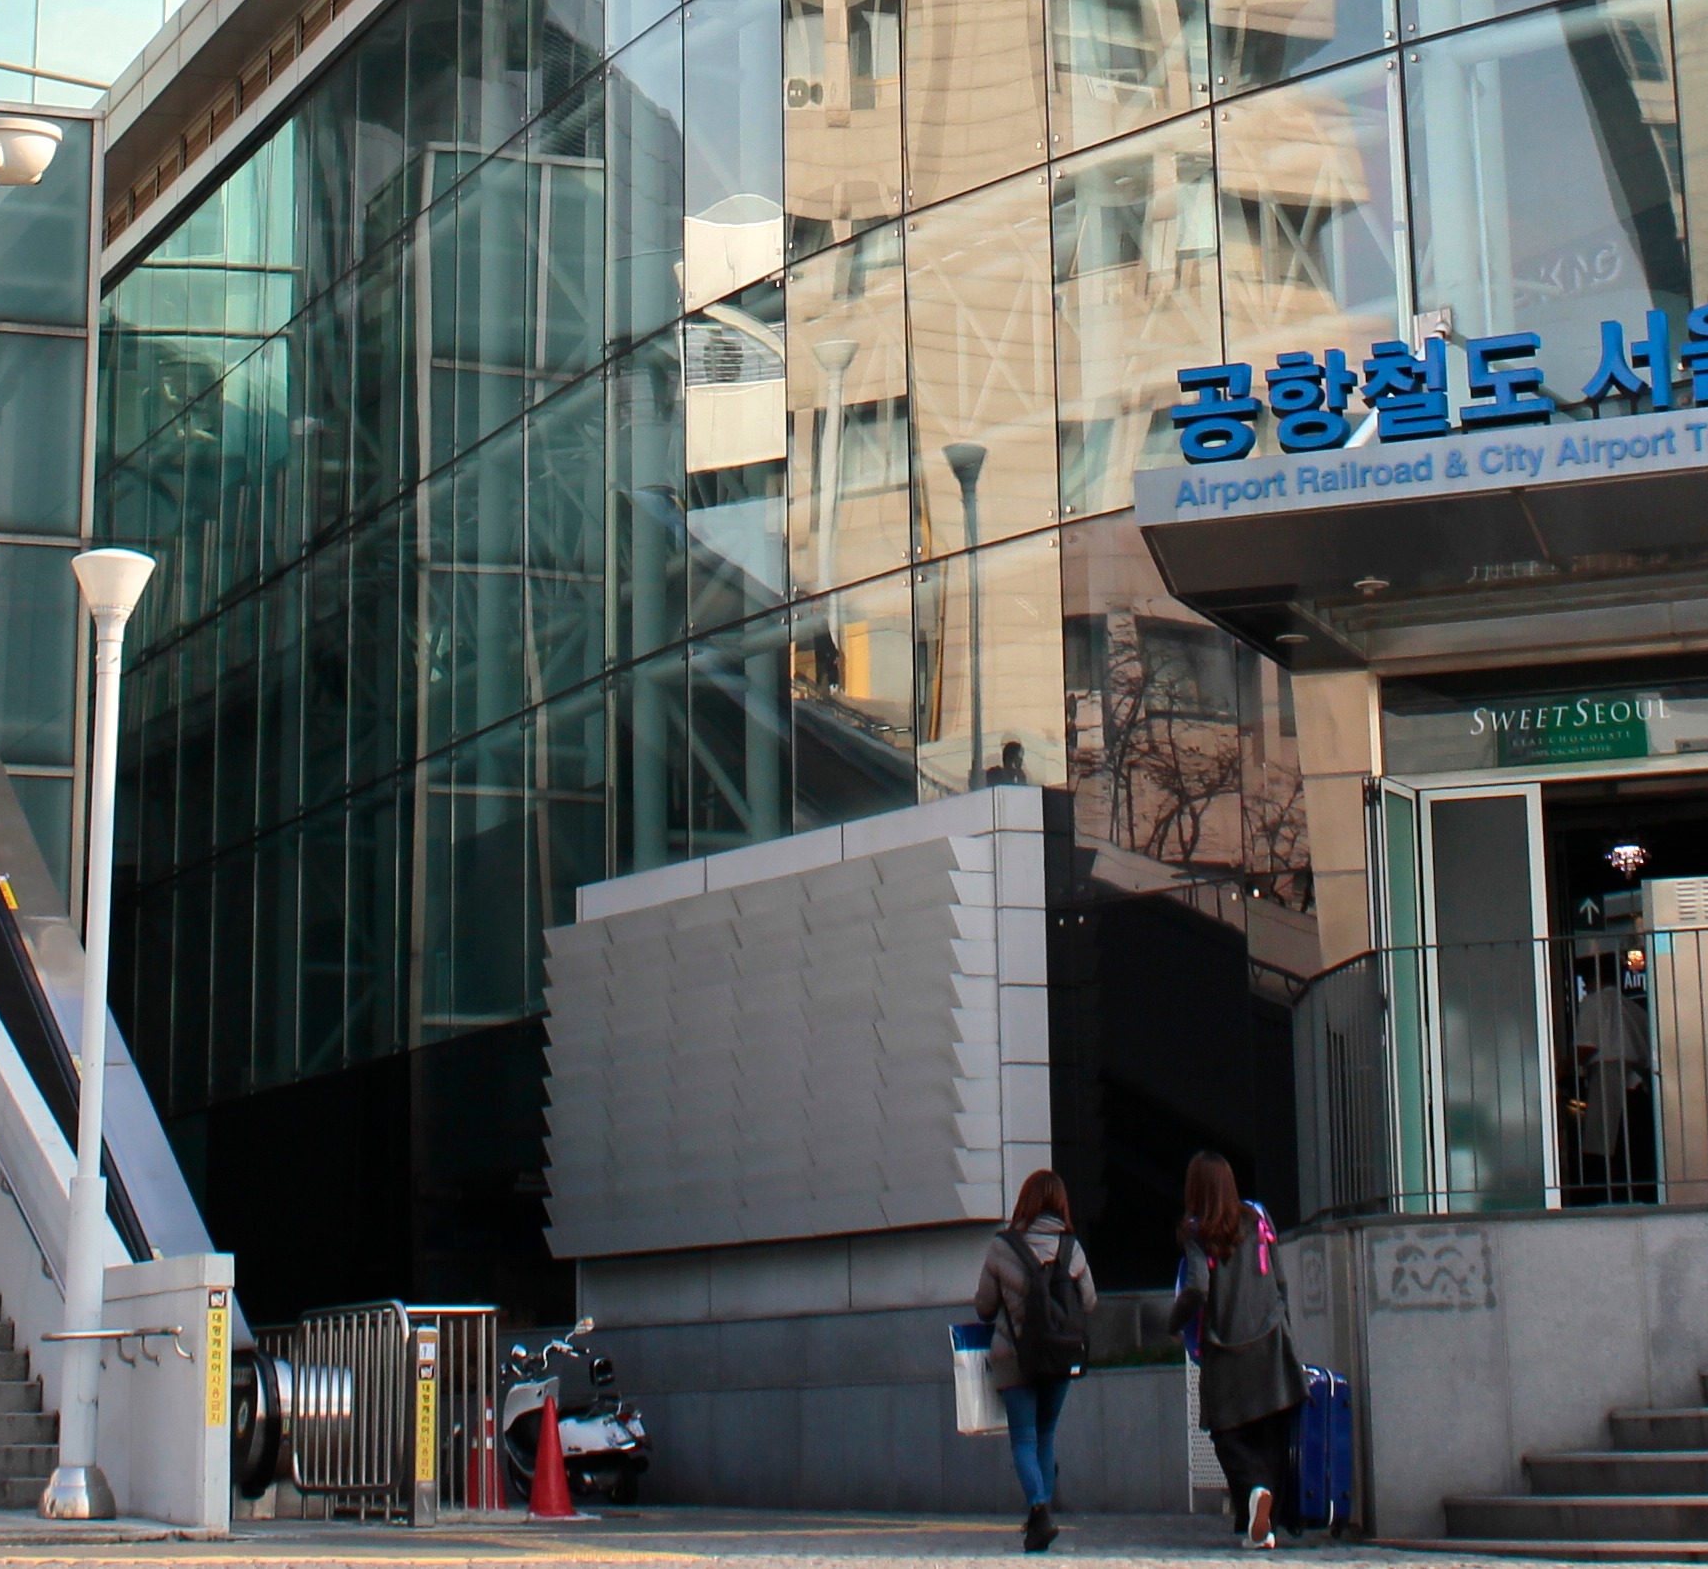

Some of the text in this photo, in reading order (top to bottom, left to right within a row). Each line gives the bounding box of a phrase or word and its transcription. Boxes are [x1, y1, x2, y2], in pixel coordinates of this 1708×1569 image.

[1171, 331, 1554, 464] 공항철도
[1175, 470, 1287, 510] Airport
[1298, 453, 1434, 494] Railroad
[1446, 449, 1468, 478] &
[1479, 443, 1545, 477] City
[1557, 426, 1677, 468] Airport
